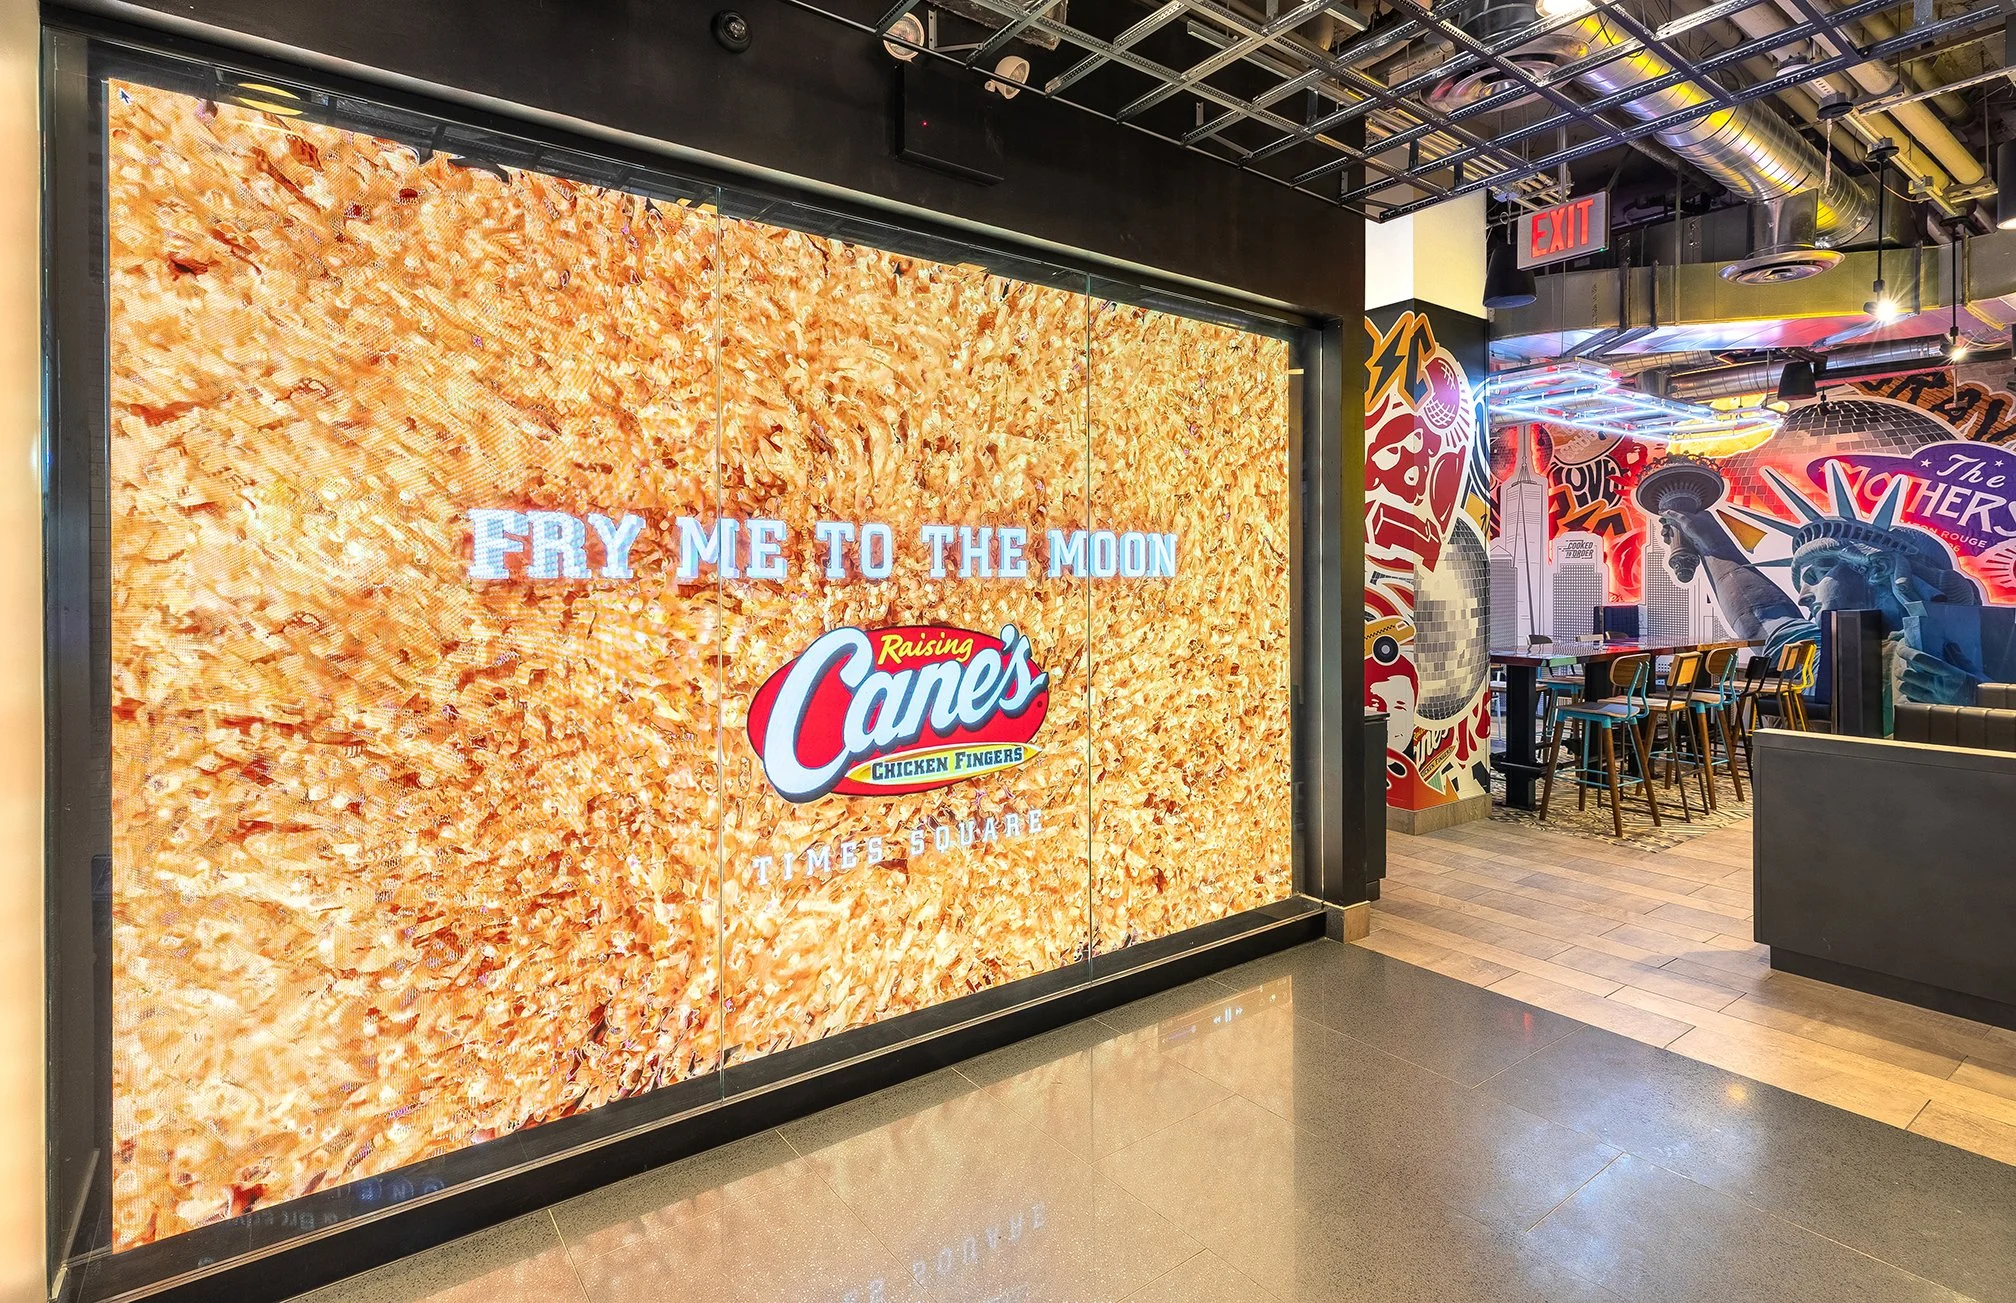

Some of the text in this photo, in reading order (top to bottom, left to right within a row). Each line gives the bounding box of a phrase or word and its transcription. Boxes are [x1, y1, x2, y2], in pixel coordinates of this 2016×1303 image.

[1531, 197, 1594, 259] EXIT
[1936, 454, 2005, 488] The
[468, 508, 1178, 579] FRY ME TO THE MOON
[1567, 541, 1594, 550] COOKED
[1572, 549, 1594, 557] ORDER
[1940, 530, 1988, 549] ROUGE
[877, 632, 974, 665] Raising
[763, 624, 1048, 803] Cane's
[872, 747, 1023, 781] CHICKEN FINGERS
[752, 808, 1043, 887] TIMES SQUARE
